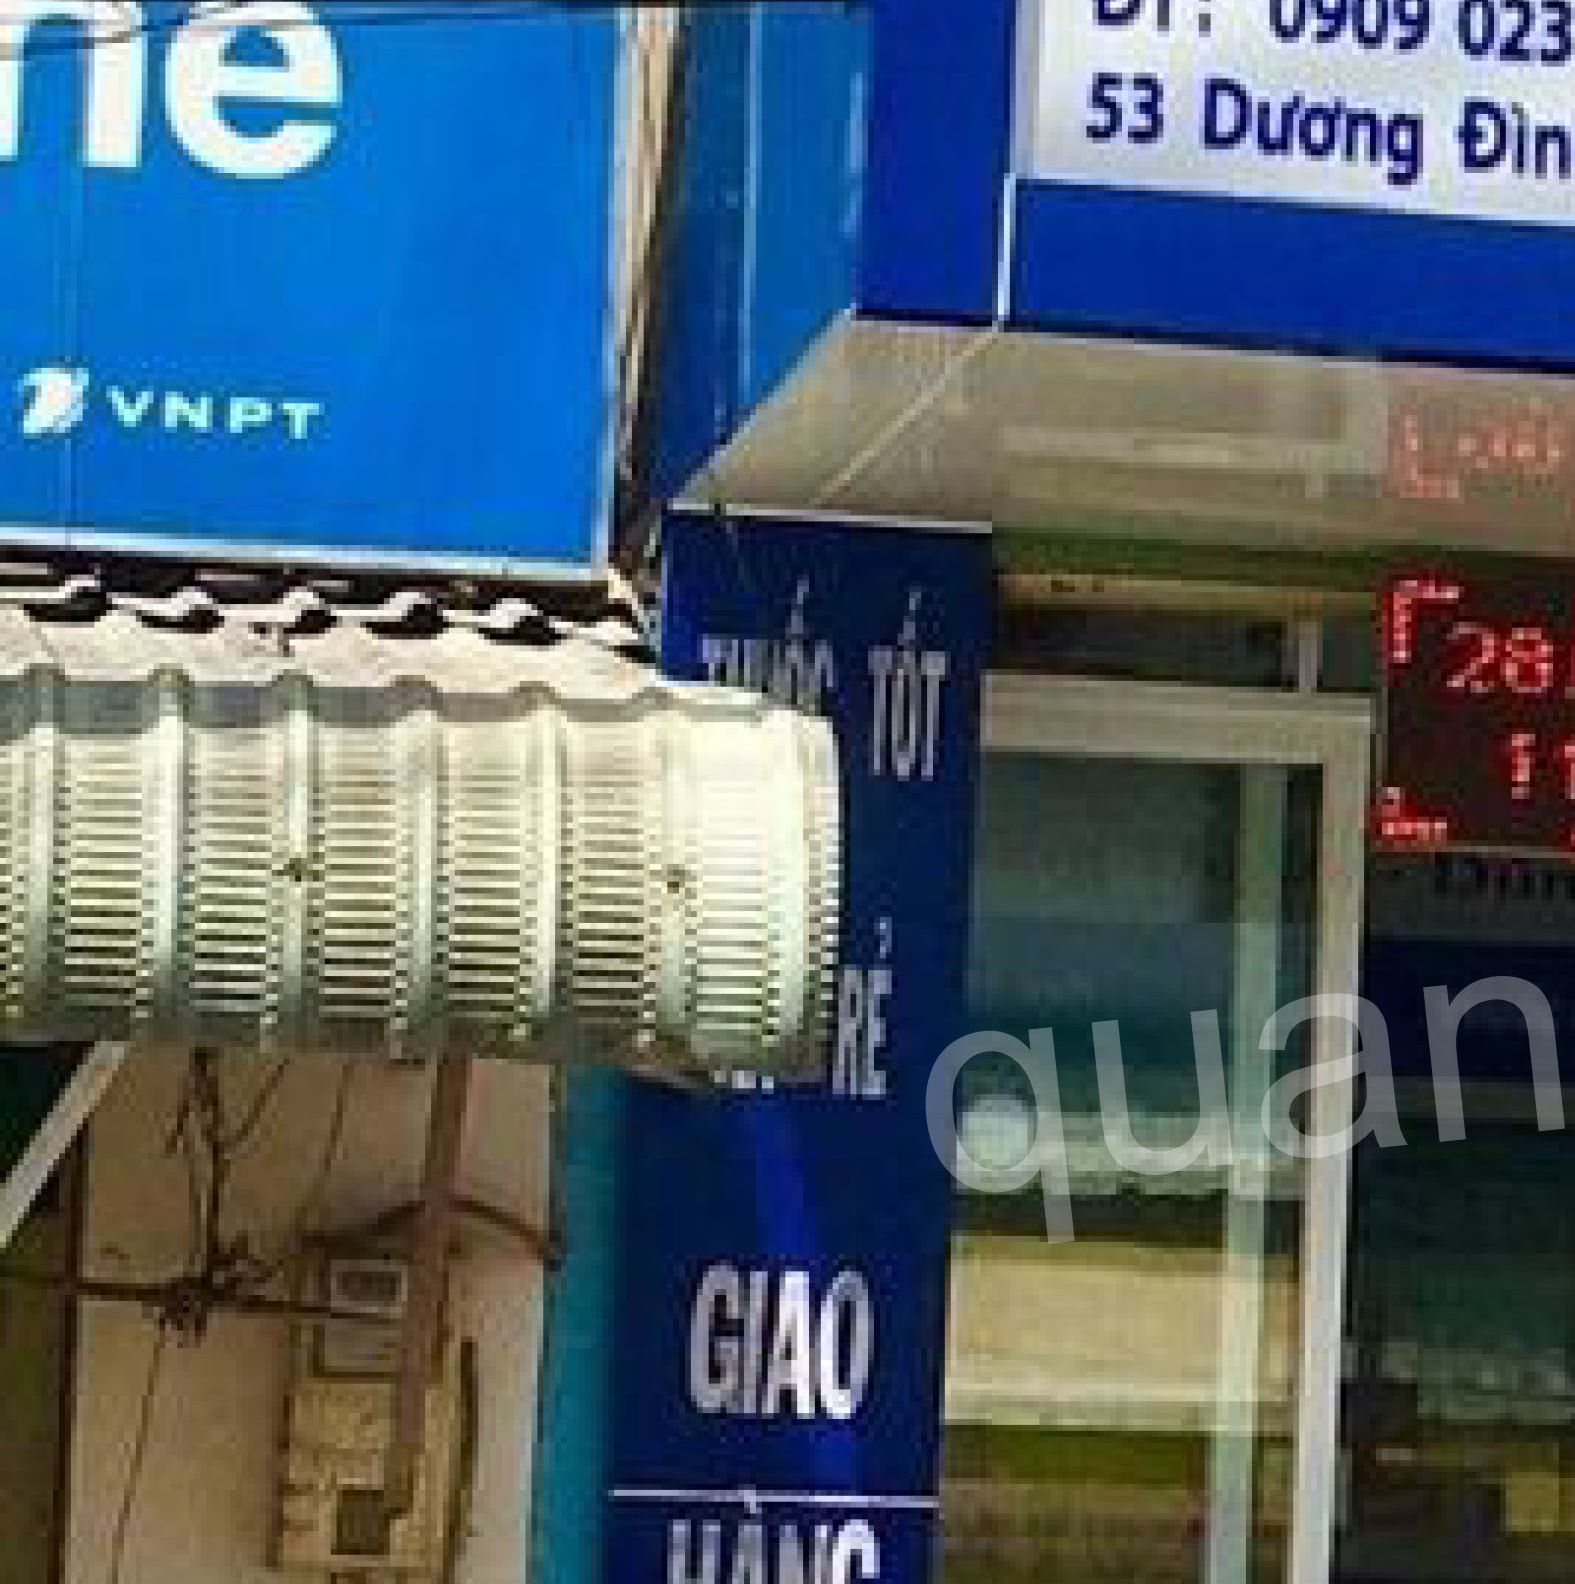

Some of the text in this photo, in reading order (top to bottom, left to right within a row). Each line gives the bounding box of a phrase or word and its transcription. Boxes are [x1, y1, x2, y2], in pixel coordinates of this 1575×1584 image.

[1084, 72, 1166, 145] 53
[1202, 78, 1424, 187] Dương
[107, 381, 322, 440] VNPT
[866, 587, 947, 782] TỐT
[688, 1262, 877, 1420] GIAO
